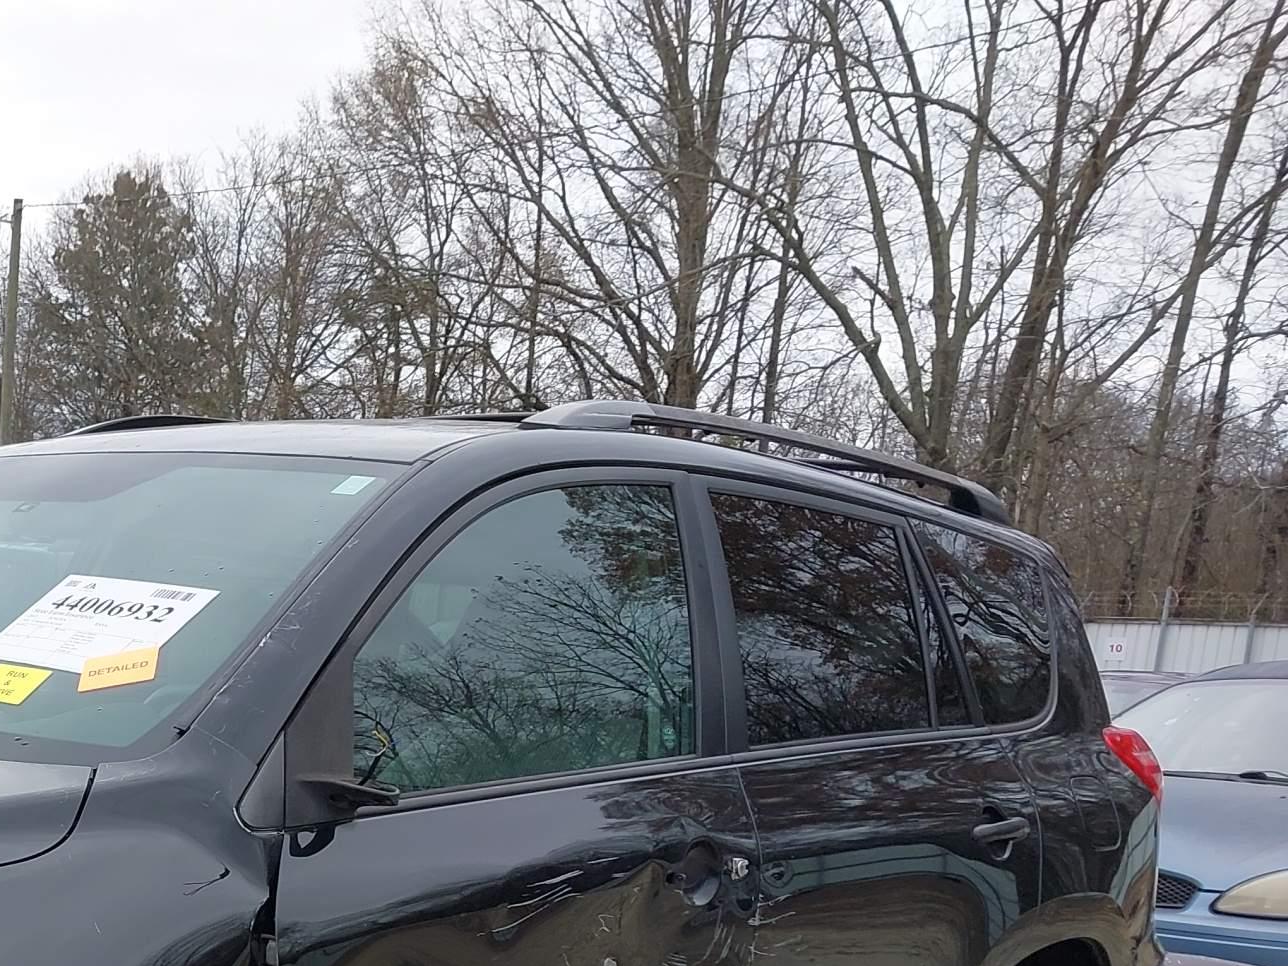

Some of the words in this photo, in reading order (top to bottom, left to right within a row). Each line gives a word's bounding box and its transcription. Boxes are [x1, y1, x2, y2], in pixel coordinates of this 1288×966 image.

[52, 594, 174, 623] 44006932
[1109, 643, 1123, 653] 10
[6, 670, 29, 679] RUN
[88, 660, 149, 677] DETAILED
